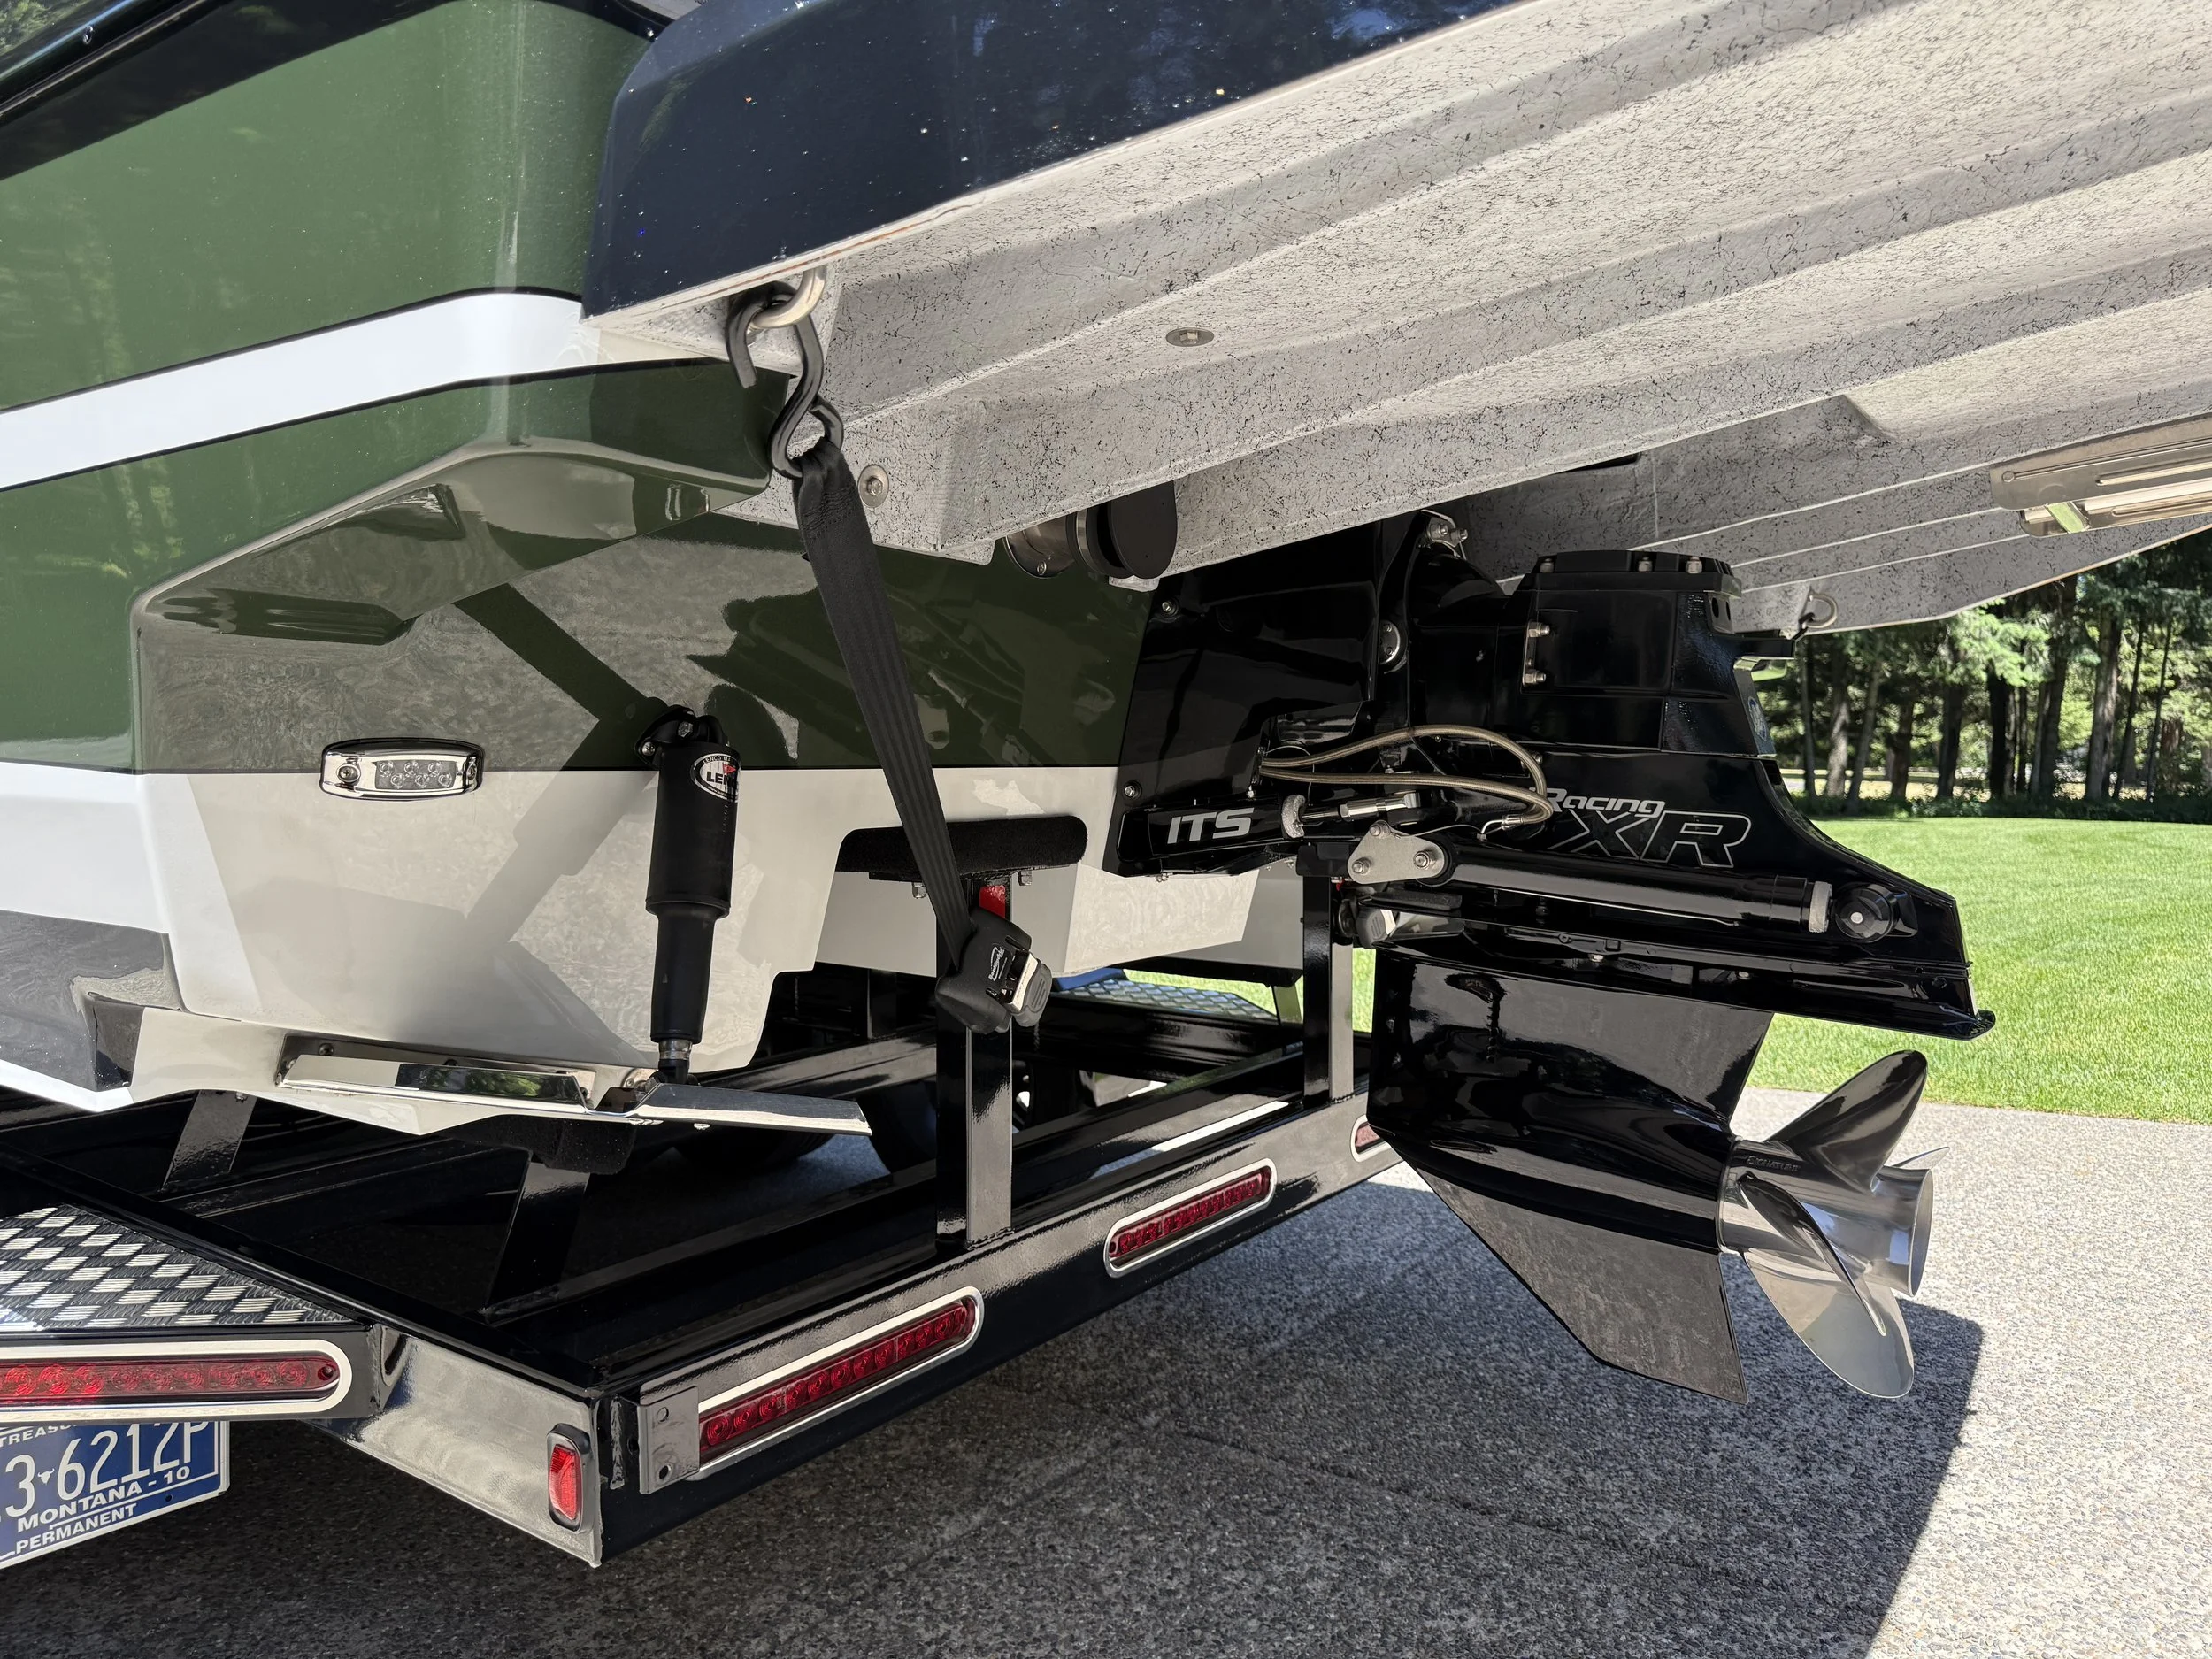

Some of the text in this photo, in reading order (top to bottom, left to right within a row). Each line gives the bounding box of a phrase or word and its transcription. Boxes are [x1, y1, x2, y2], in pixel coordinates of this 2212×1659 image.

[1167, 807, 1255, 844] ITS
[1530, 787, 1666, 818] Racing
[1547, 810, 1752, 868] XR
[18, 1480, 143, 1532] MONTANA
[164, 1465, 191, 1485] 10
[16, 1502, 137, 1555] PERMANENT
